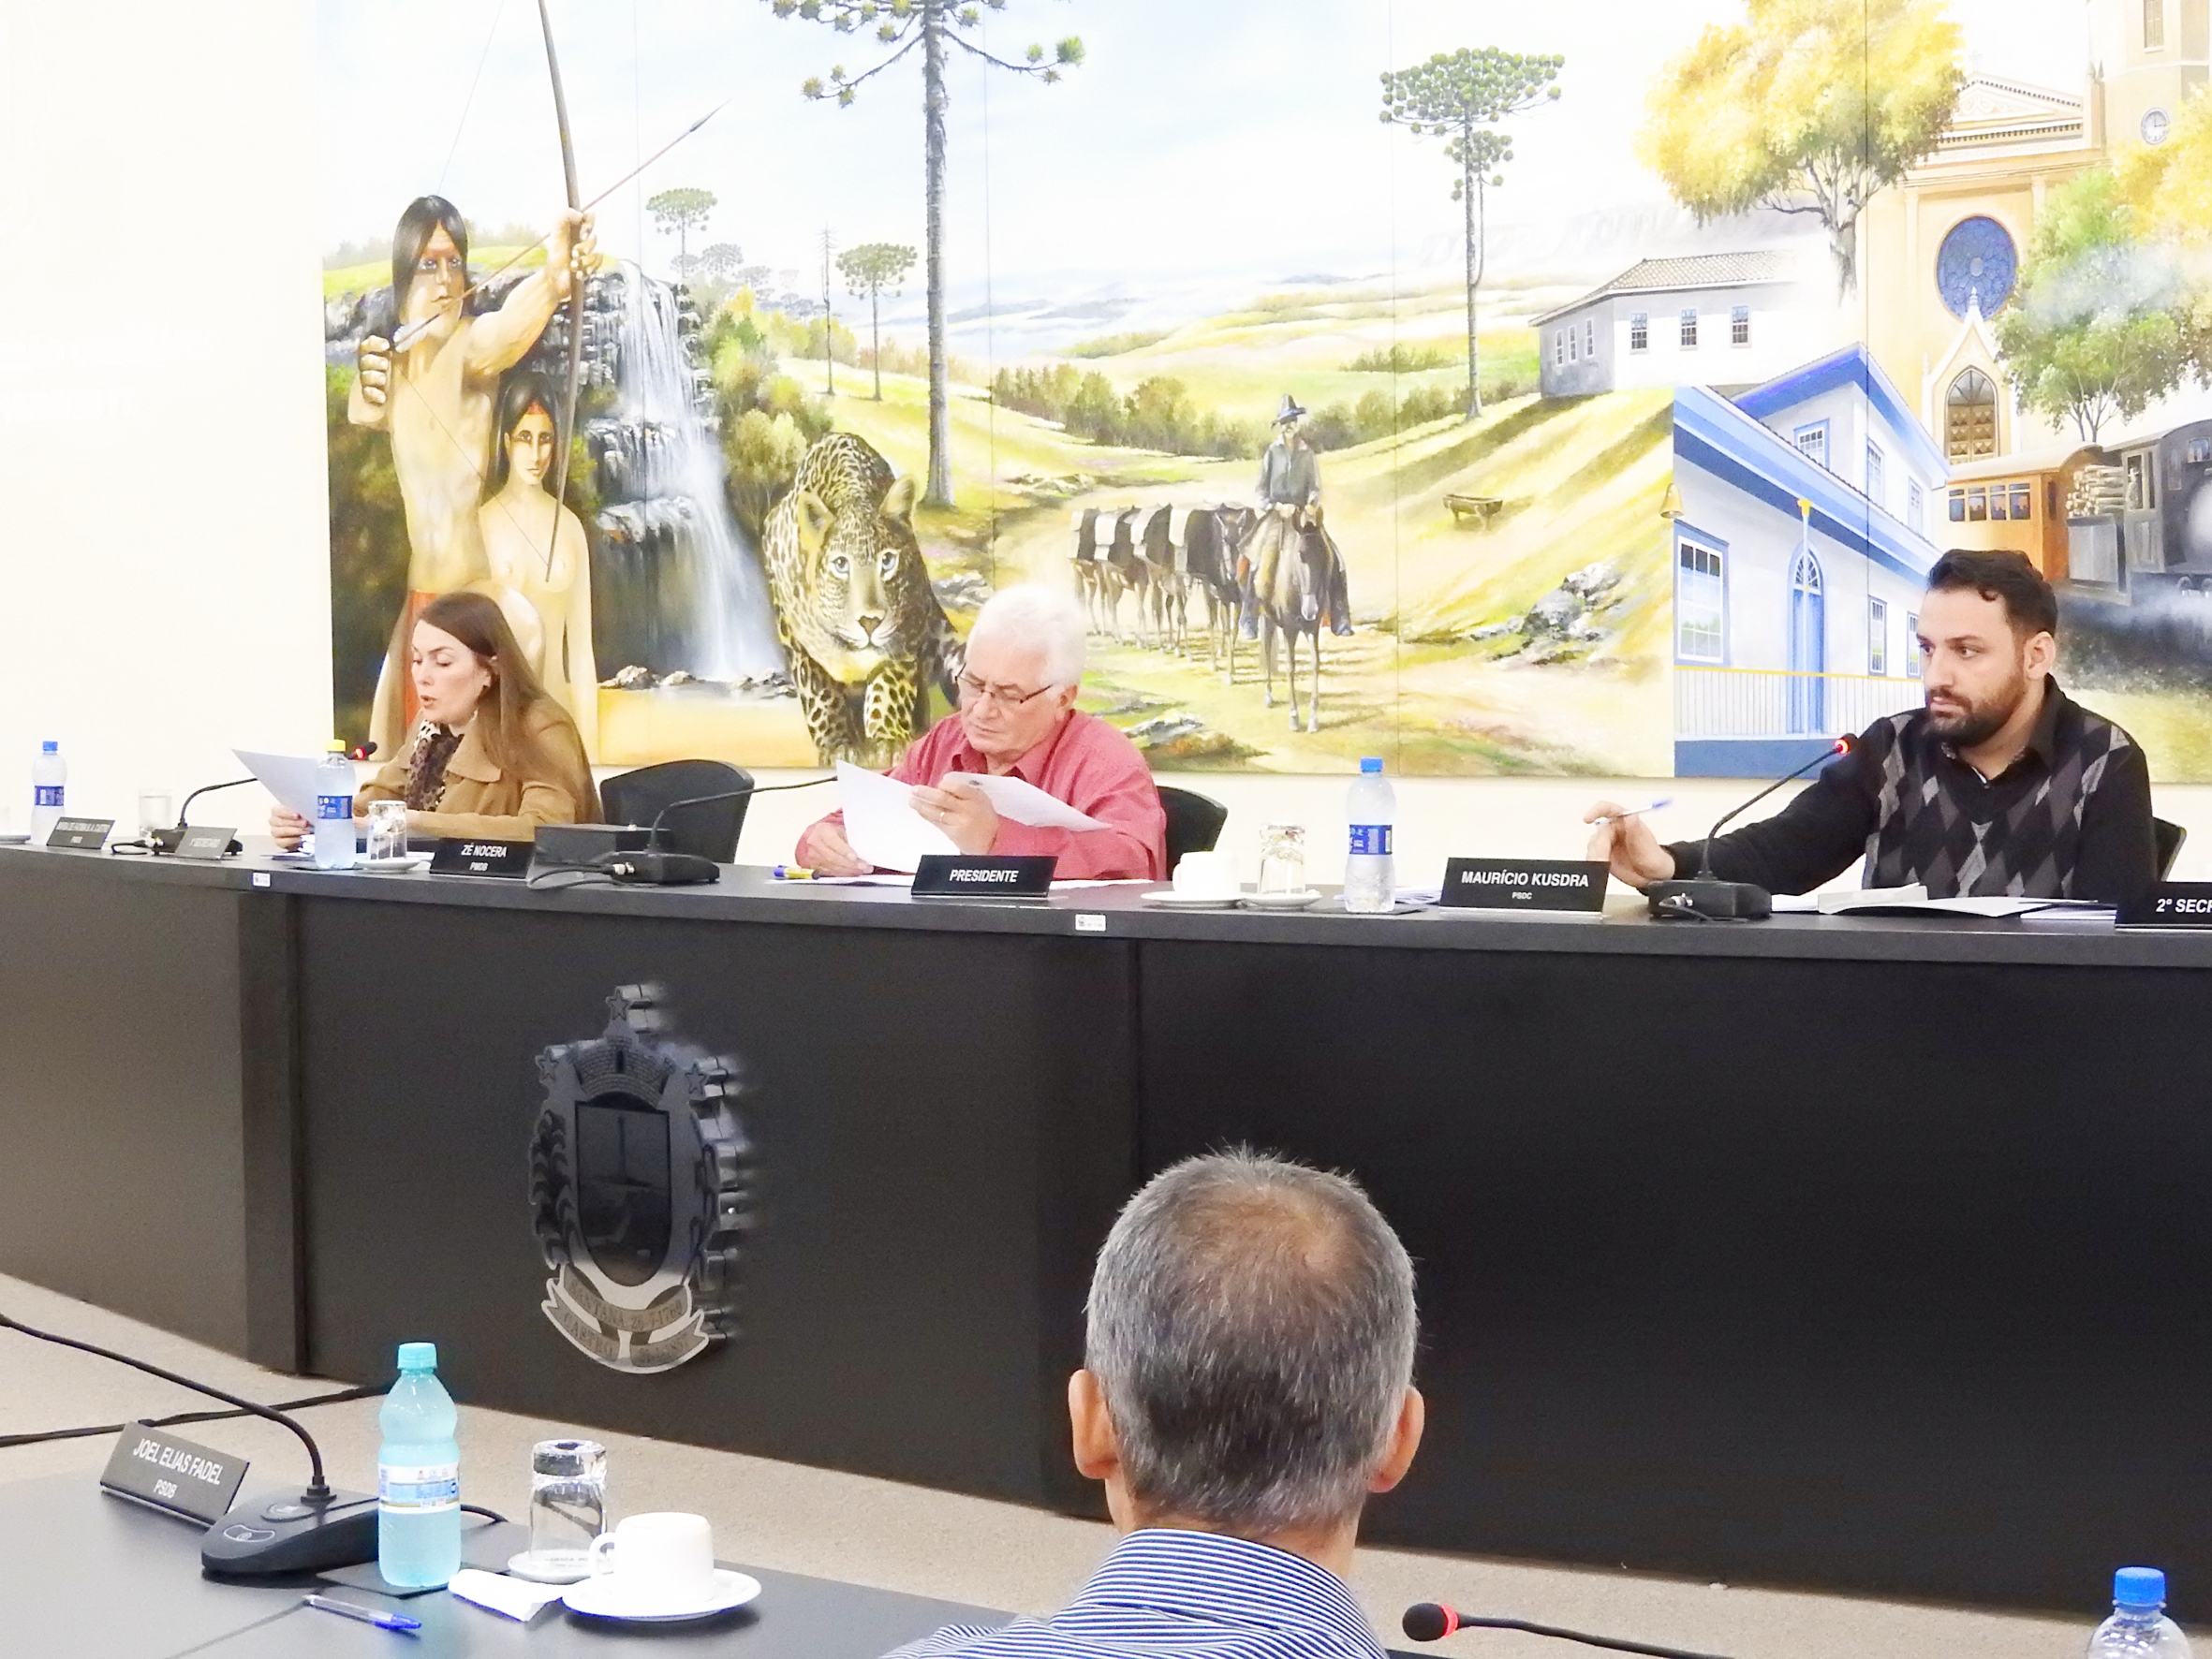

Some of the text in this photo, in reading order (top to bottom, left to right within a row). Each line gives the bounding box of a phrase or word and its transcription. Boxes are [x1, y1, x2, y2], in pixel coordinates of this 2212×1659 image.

[461, 843, 508, 858] ZÉ NOCERA
[949, 869, 1019, 883] PRESIDENTE
[1461, 869, 1589, 888] MAURÍCIO KUSDRA
[1512, 891, 1533, 900] PSDC
[133, 1438, 224, 1486] JOEL ELIAS FADEL
[153, 1478, 178, 1499] PSDB
